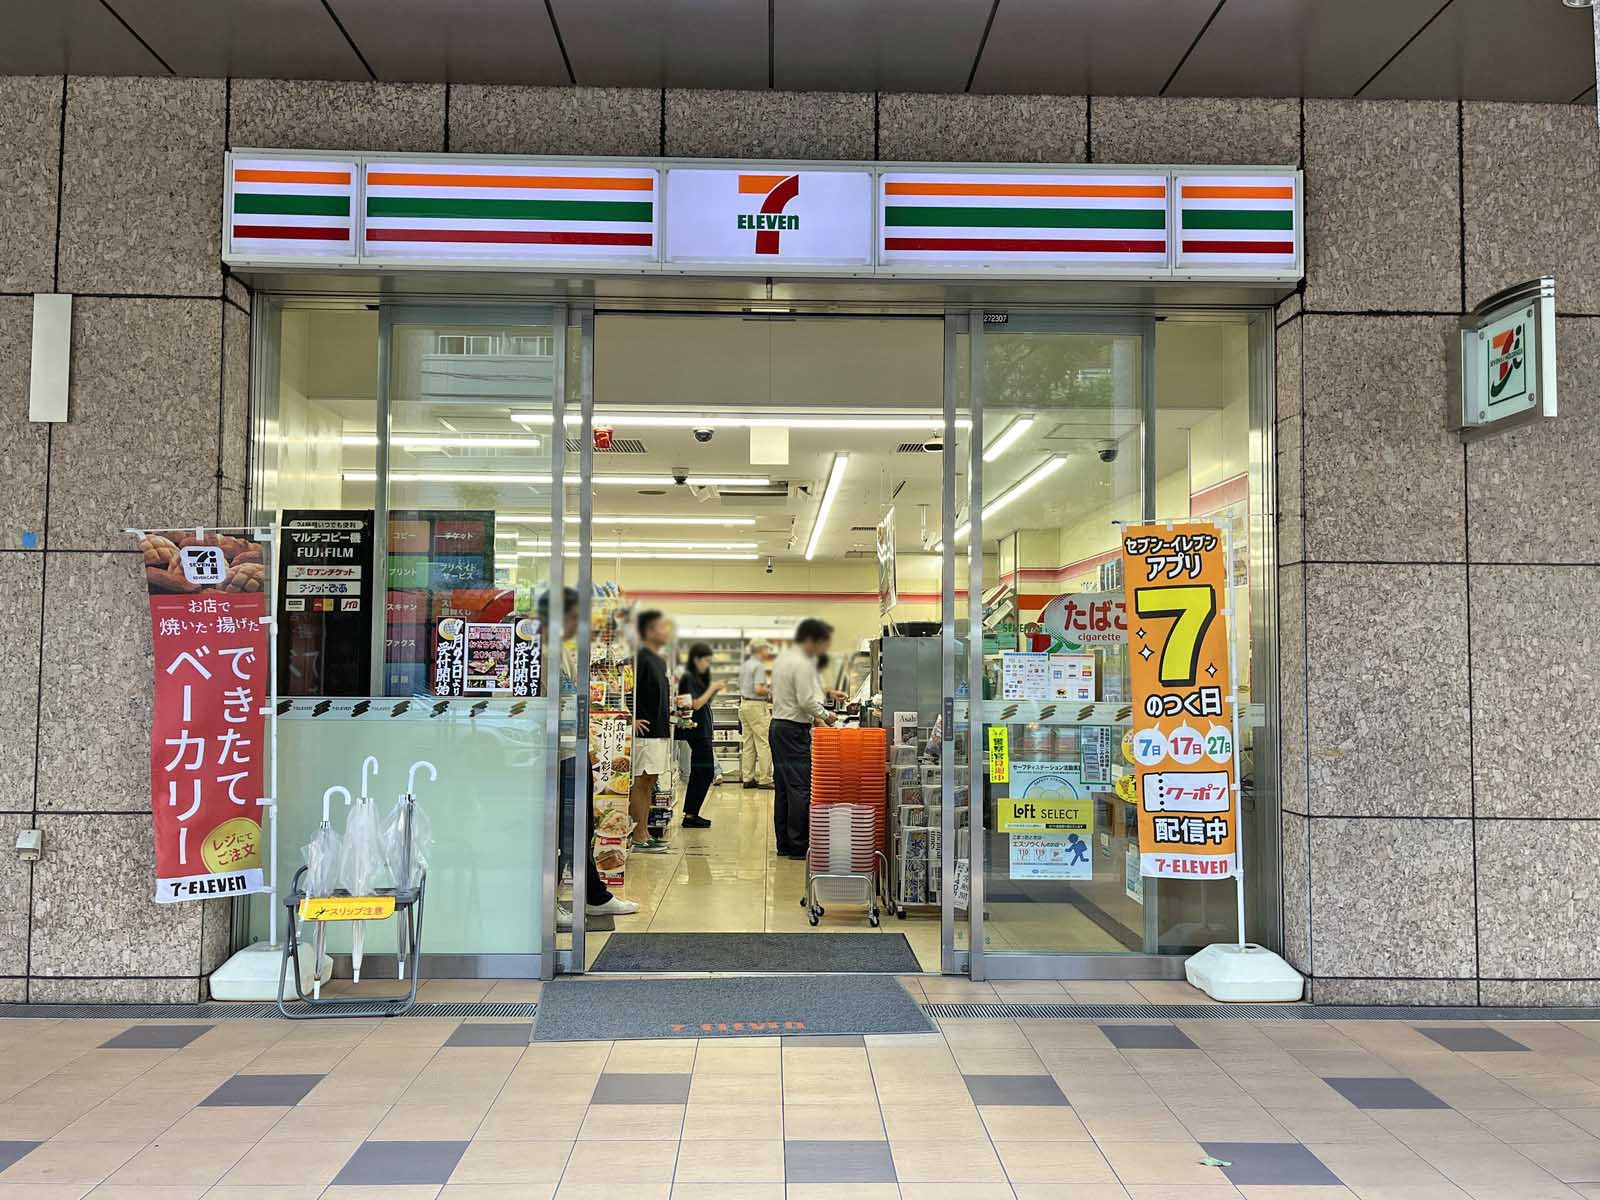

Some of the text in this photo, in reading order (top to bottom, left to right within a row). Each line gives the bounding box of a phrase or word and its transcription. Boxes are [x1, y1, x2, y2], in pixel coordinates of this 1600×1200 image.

[291, 532, 361, 543] マルチコピー機
[296, 547, 354, 557] FUJIFILM
[307, 568, 355, 576] セブンチケット
[388, 568, 417, 576] プリント
[443, 572, 474, 580] サービス
[1146, 553, 1202, 580] アプリ
[300, 584, 348, 593] チケットぴあ
[188, 598, 231, 613] お店で
[387, 603, 417, 611] スキャン
[1078, 633, 1121, 641] cigarette
[1136, 585, 1215, 686] 7
[435, 641, 451, 696] 受付開始
[513, 641, 529, 697] 受付開始
[1147, 687, 1222, 716] のつく日
[216, 646, 256, 806] できたて
[615, 722, 625, 752] 食卓を
[1139, 736, 1230, 756] 7日 17日 27日
[164, 644, 213, 865] ベーカリー
[600, 721, 613, 782] おいしく彩る
[1166, 784, 1226, 800] クーポン
[1041, 809, 1079, 819] SELECT
[1155, 818, 1228, 844] 配信中
[212, 832, 253, 850] レジにて
[217, 842, 256, 866] ご注文
